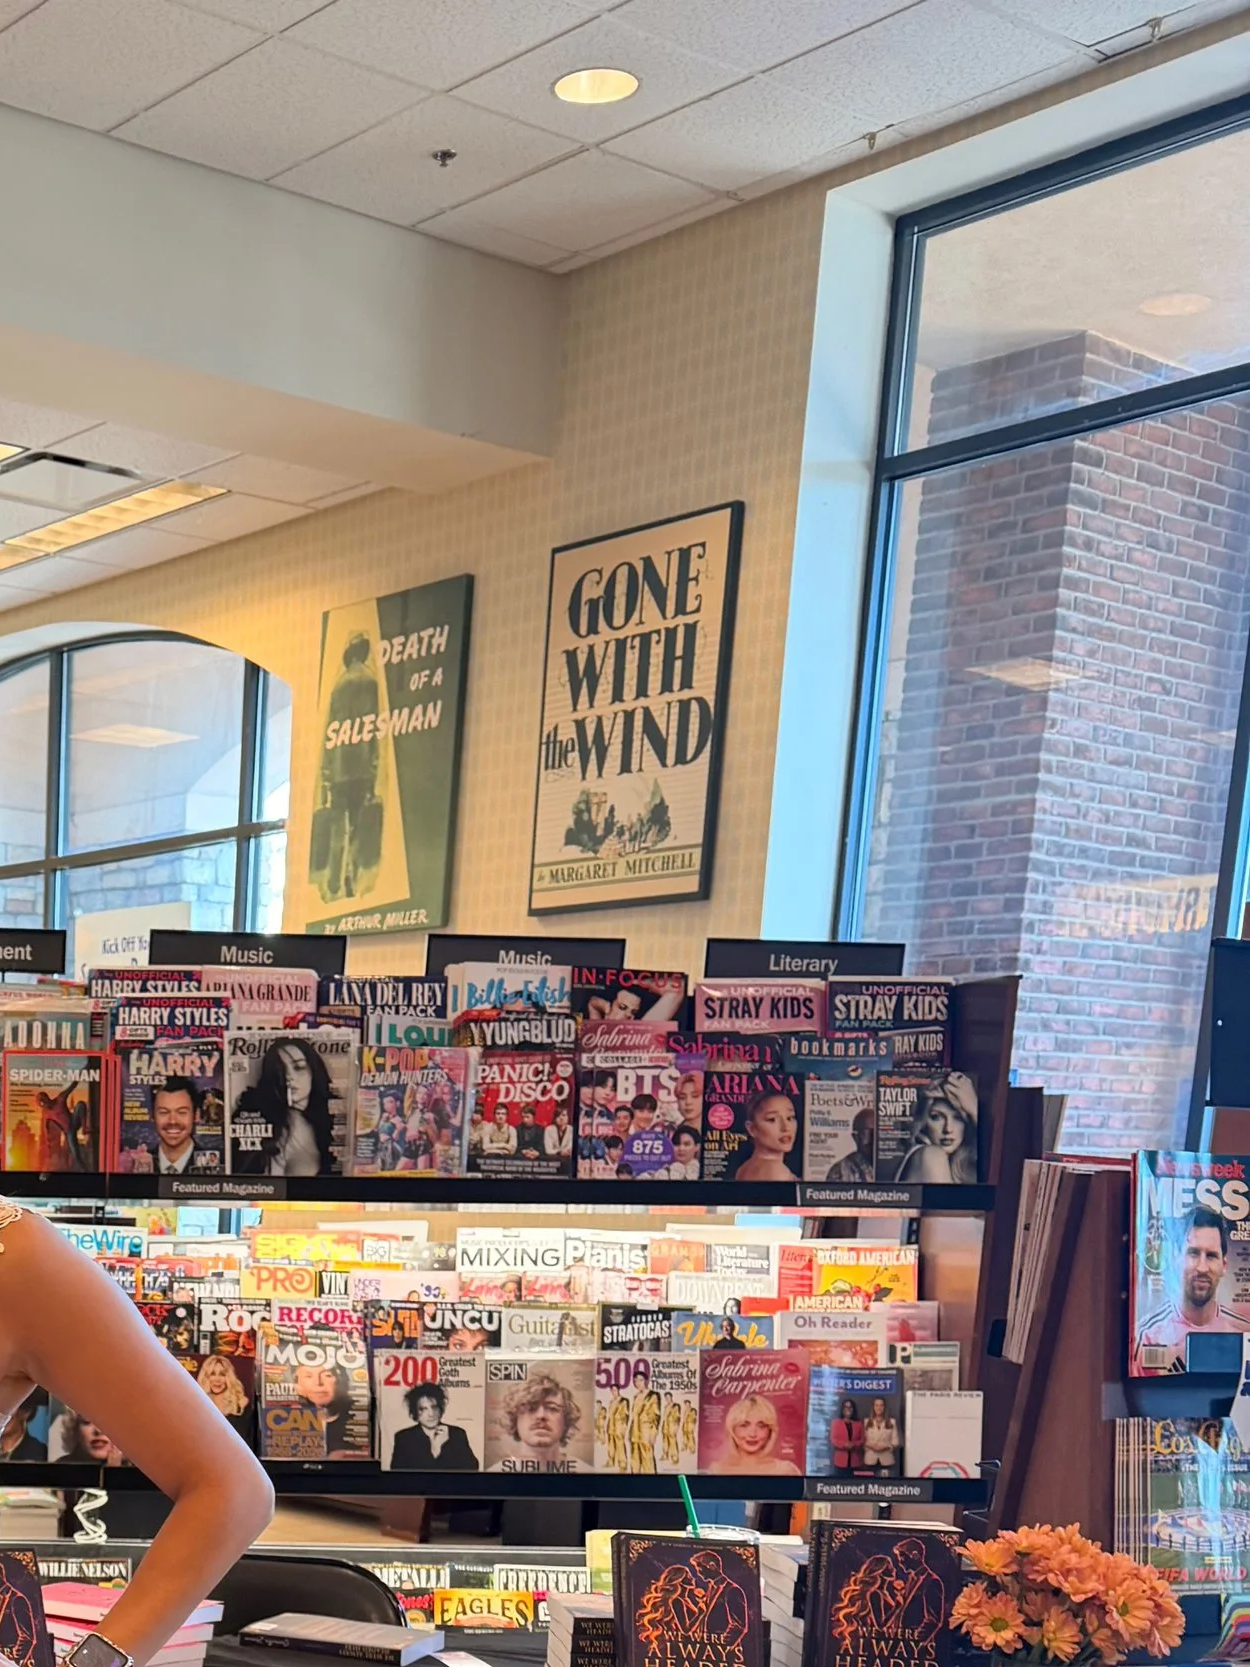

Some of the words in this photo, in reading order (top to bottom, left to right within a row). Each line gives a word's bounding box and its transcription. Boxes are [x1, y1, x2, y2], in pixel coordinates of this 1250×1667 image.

[567, 542, 707, 639] GONE
[377, 625, 449, 665] DEATH
[563, 621, 700, 711] WITH
[410, 672, 428, 691] OF
[431, 670, 443, 686] A
[325, 701, 441, 750] SALESMAN
[541, 725, 575, 774] the
[572, 696, 713, 781] WIND
[549, 861, 617, 886] MARGARET
[625, 851, 697, 876] MITCHELL
[338, 915, 381, 934] ARTHUR
[384, 908, 429, 929] MILLER
[221, 945, 274, 964] Music
[500, 949, 552, 966] Music
[769, 953, 838, 976] Literary
[91, 981, 142, 998] HARRY
[147, 980, 199, 993] STYLES
[257, 984, 311, 1002] GRANDE
[329, 982, 377, 1005] LANA
[378, 983, 410, 1005] DEL
[413, 982, 446, 1006] REY
[731, 986, 815, 997] UNOFFICIAL
[862, 985, 950, 995] UNOFFICIAL
[142, 997, 215, 1007] UNOFFICIAL
[243, 1001, 272, 1013] FAN
[704, 997, 763, 1020] STRAY
[770, 996, 815, 1020] KIDS
[834, 994, 898, 1021] STRAY
[902, 995, 950, 1021] KIDS
[119, 1008, 170, 1026] HARRY
[174, 1007, 229, 1026] STYLES
[366, 1005, 399, 1017] FAN
[401, 1005, 437, 1018] PACK
[156, 1026, 186, 1037] FAN
[703, 1020, 733, 1030] FAN
[736, 1020, 772, 1030] PACK
[835, 1020, 859, 1029] FAN
[861, 1020, 894, 1030] PACK
[582, 1023, 651, 1050] Sabrina
[918, 1033, 944, 1052] KIDS
[668, 1034, 759, 1061] Sabrina
[790, 1036, 887, 1056] bookmarks
[130, 1049, 220, 1077] HARRY
[362, 1047, 429, 1073] K-POP
[9, 1069, 101, 1083] SPIDER-MAN
[130, 1075, 167, 1085] STYLES
[360, 1071, 399, 1086] DEMON
[401, 1068, 449, 1086] HUNTERS
[477, 1062, 551, 1084] PANIC!
[497, 1080, 571, 1103] DISCO
[616, 1068, 681, 1102] BTS
[707, 1073, 800, 1096] ARIANA
[878, 1087, 918, 1103] TAYLOR
[878, 1102, 911, 1117] SWIFT
[230, 1124, 273, 1138] CHARLI
[705, 1130, 720, 1141] All
[238, 1137, 263, 1150] XCX
[632, 1140, 664, 1155] 875
[704, 1142, 718, 1151] on
[724, 1140, 739, 1151] Ari
[172, 1180, 221, 1195] Featured
[225, 1181, 275, 1197] Magazine
[806, 1187, 854, 1201] Featured
[857, 1189, 910, 1203] Magazine
[461, 1247, 560, 1267] MIXING
[816, 1250, 857, 1266] OXFORD
[858, 1249, 915, 1266] AMERICAN
[795, 1295, 863, 1309] AMERICAN
[794, 1316, 817, 1329] Oh
[821, 1316, 872, 1329] Reader
[265, 1344, 366, 1369] MOJO
[383, 1355, 438, 1388] 200
[439, 1357, 476, 1368] Greatest
[439, 1368, 460, 1378] Goth
[490, 1363, 527, 1381] SPIN
[595, 1357, 651, 1391] 500
[651, 1358, 690, 1370] Greatest
[651, 1369, 683, 1381] Albums
[686, 1369, 697, 1380] Of
[706, 1355, 781, 1381] Sabrina
[265, 1383, 298, 1395] PAUL
[439, 1378, 471, 1389] Albums
[651, 1380, 667, 1391] The
[669, 1379, 698, 1391] 1950s
[712, 1374, 801, 1400] Carpenter
[853, 1379, 892, 1390] DIGEST
[266, 1408, 324, 1432] CAN
[272, 1435, 322, 1447] REPLAY
[501, 1459, 578, 1473] SUBLIME
[817, 1483, 865, 1495] Featured
[868, 1484, 921, 1497] Magazine
[39, 1561, 81, 1577] WILLIE
[83, 1562, 128, 1578] NELSON
[1194, 1565, 1248, 1583] WORLD
[439, 1596, 532, 1627] EAGLES
[662, 1631, 685, 1642] WE
[688, 1631, 727, 1644] WERE
[857, 1626, 878, 1637] WE
[881, 1628, 922, 1640] WERE
[648, 1642, 744, 1664] ALWAYS
[840, 1638, 937, 1660] ALWAYS
